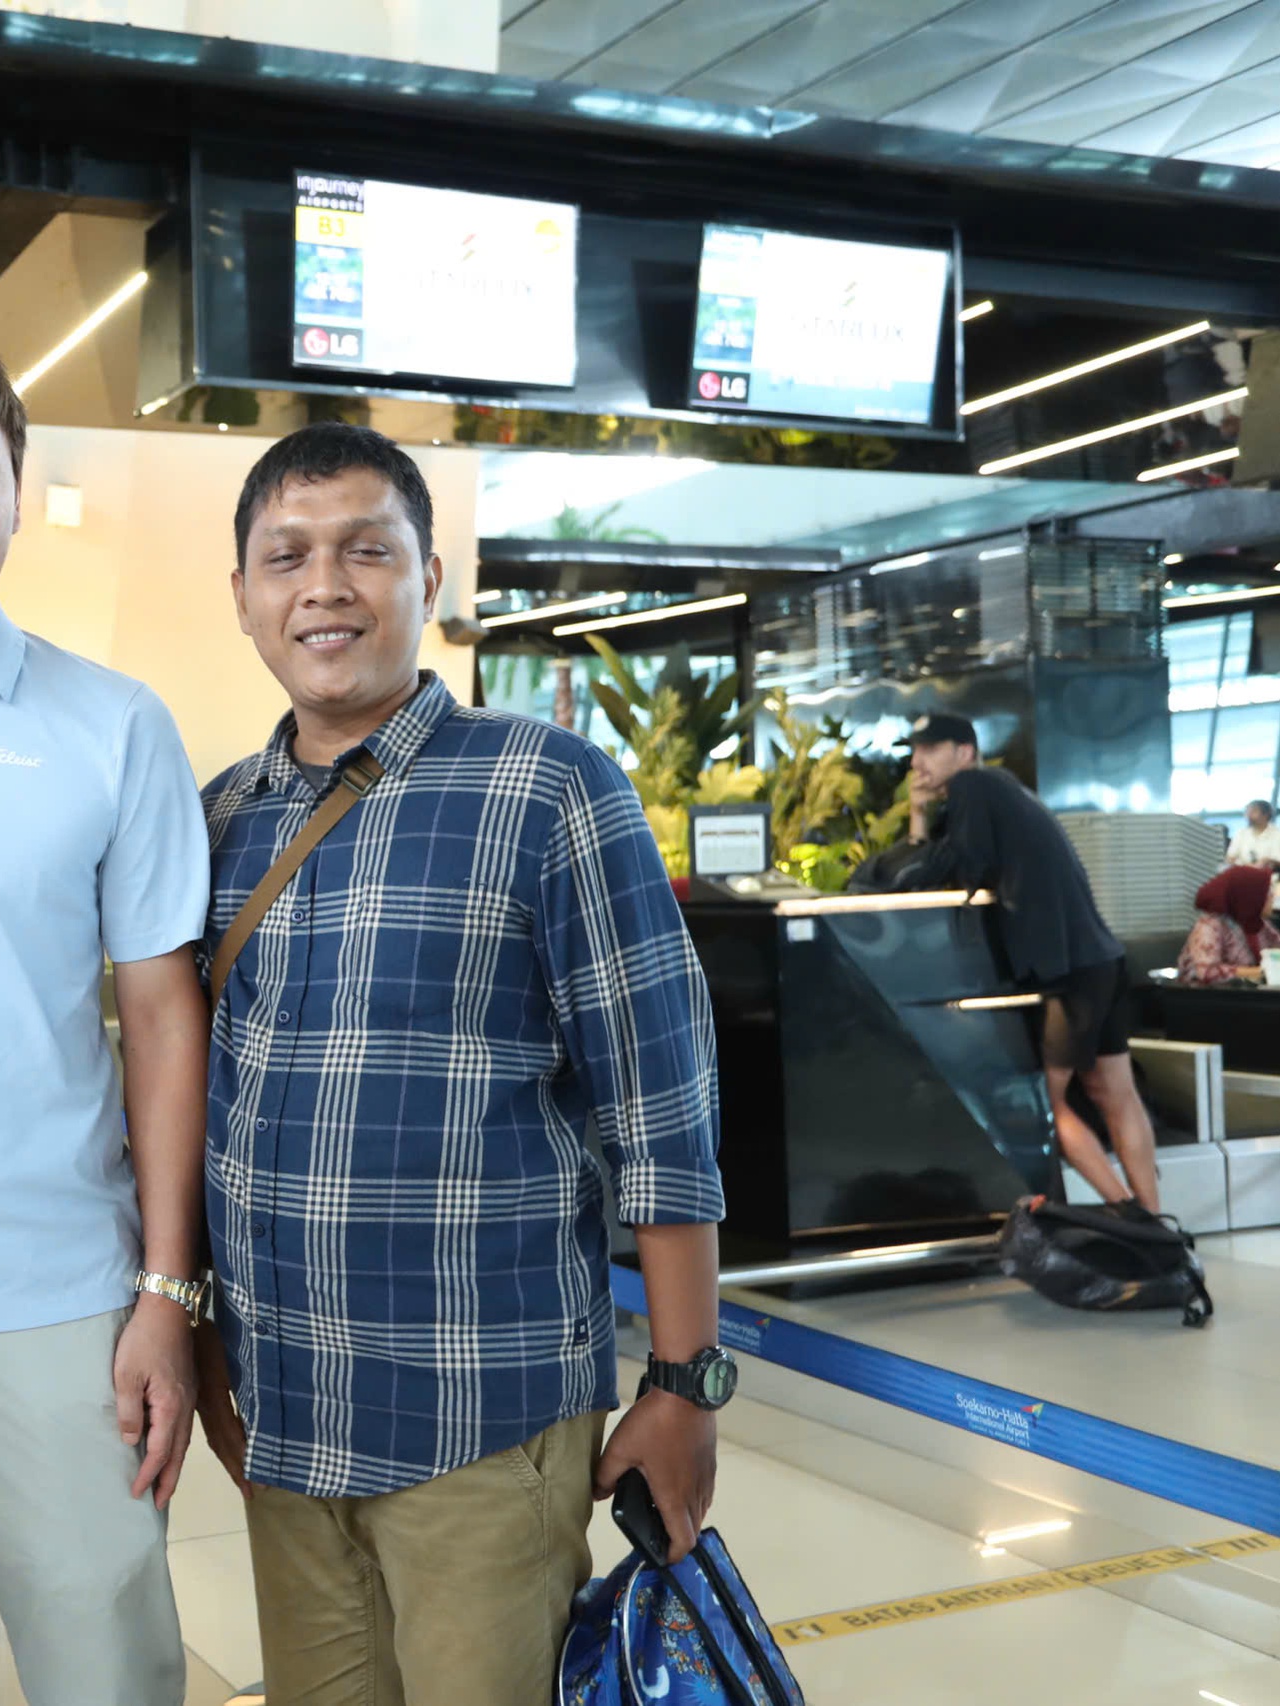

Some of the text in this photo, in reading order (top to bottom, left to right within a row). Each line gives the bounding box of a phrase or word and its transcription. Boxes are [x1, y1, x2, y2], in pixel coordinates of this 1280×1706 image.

[330, 333, 359, 357] LG
[721, 376, 747, 399] LG
[841, 1602, 935, 1628] BATAS
[935, 1577, 1053, 1609] ANTRIAN
